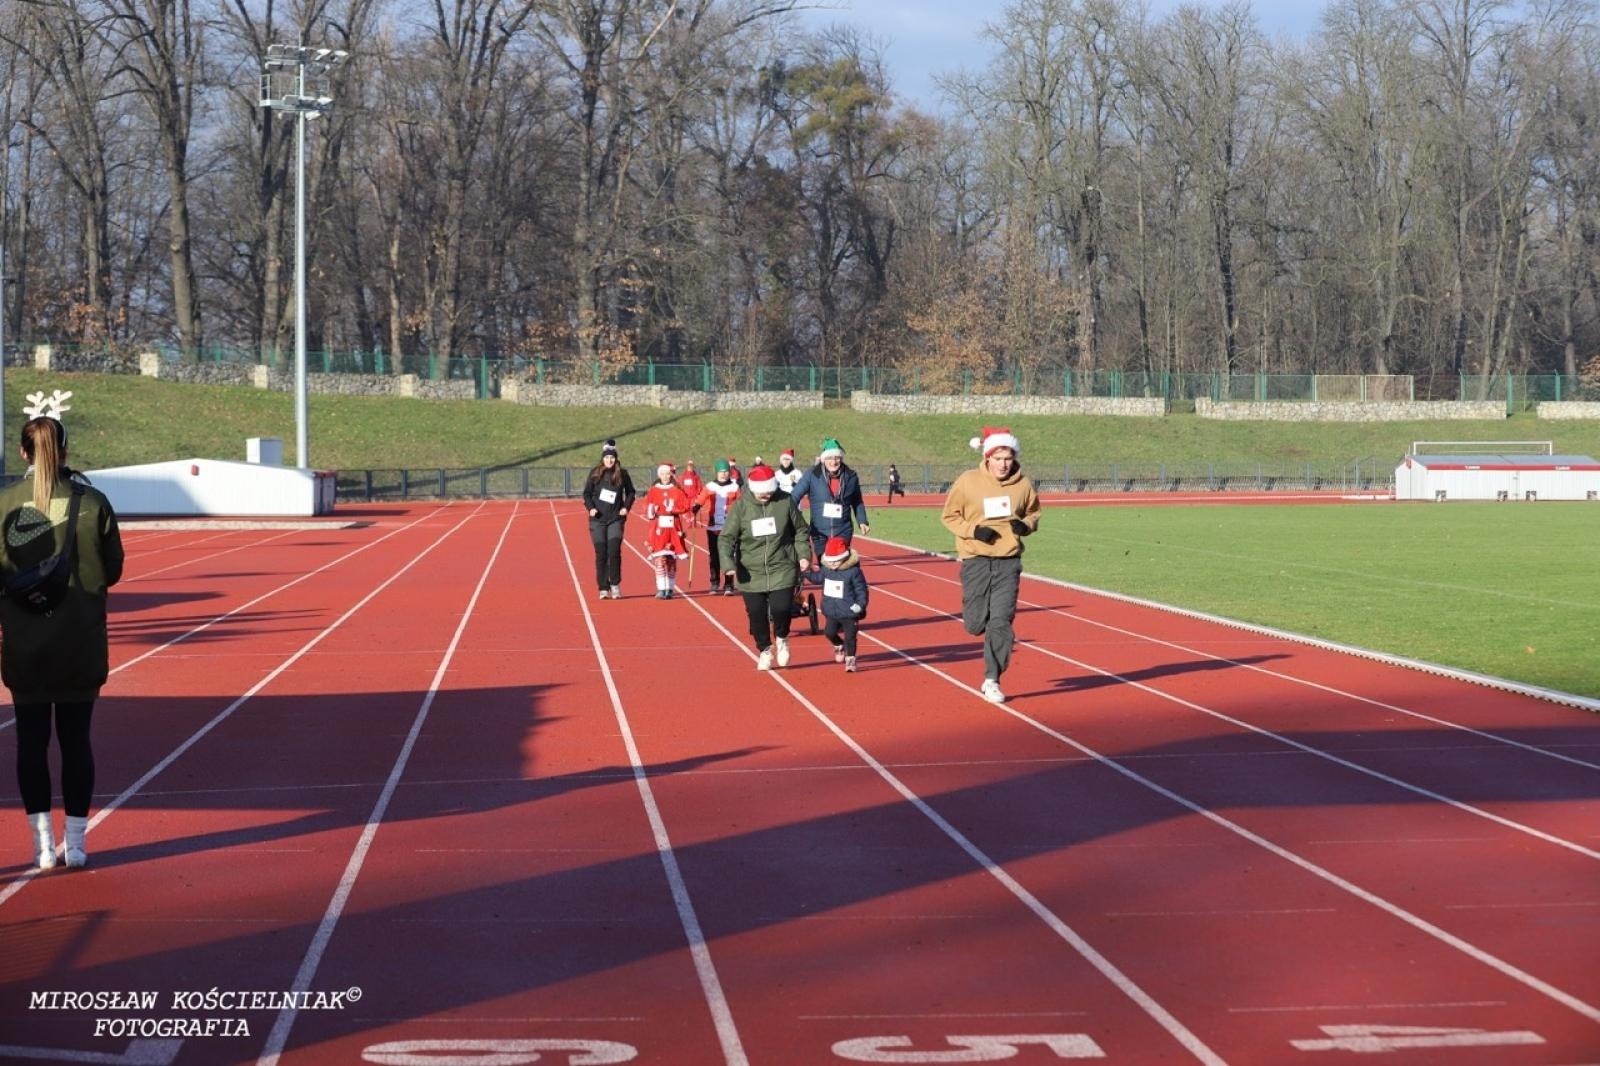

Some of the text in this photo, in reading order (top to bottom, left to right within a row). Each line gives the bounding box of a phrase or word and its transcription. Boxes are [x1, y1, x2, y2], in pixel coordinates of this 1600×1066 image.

[361, 1038, 638, 1066] 6
[830, 1033, 1107, 1063] 5
[1289, 1024, 1547, 1053] 4
